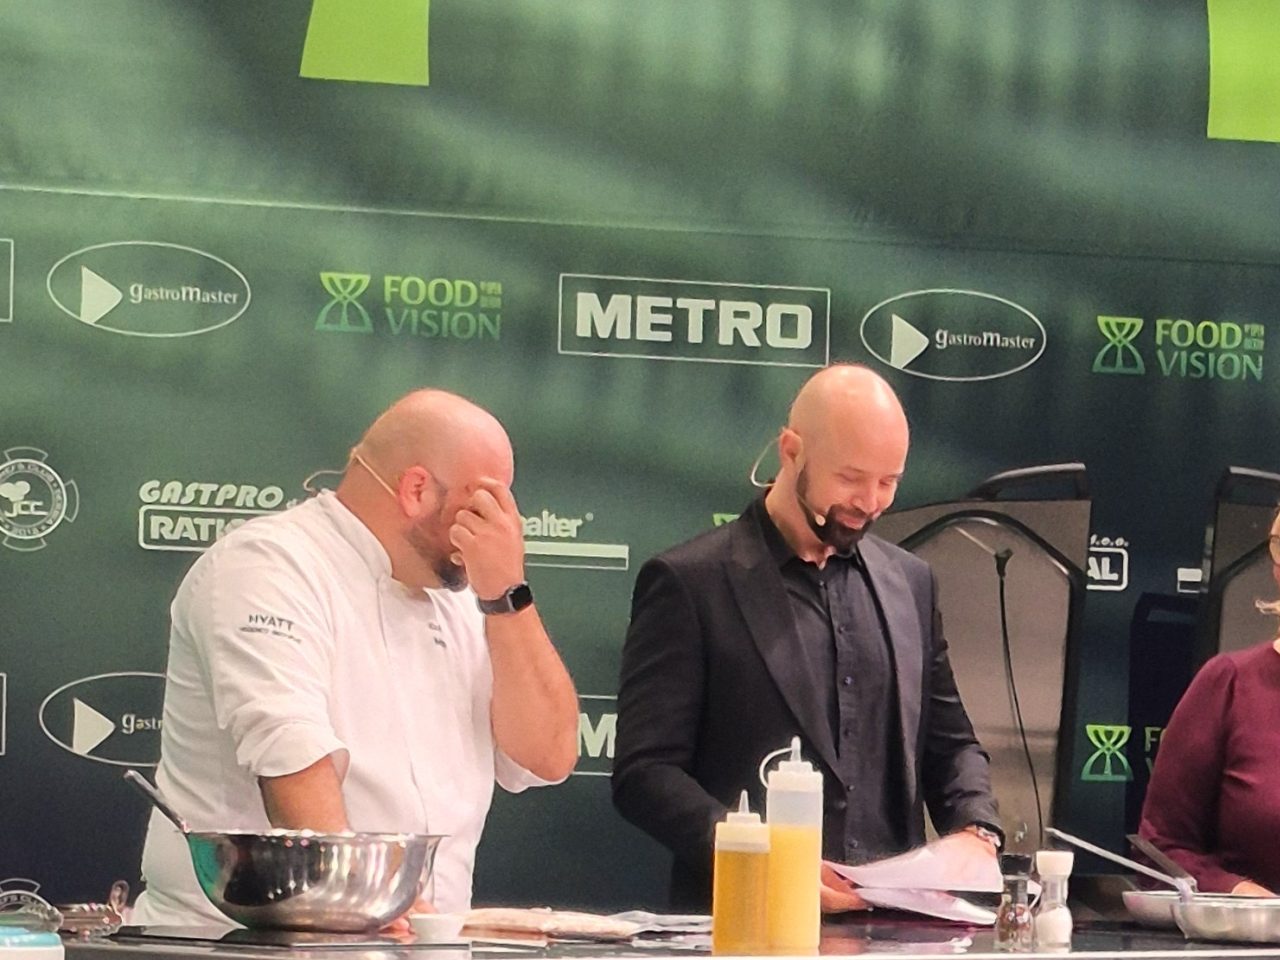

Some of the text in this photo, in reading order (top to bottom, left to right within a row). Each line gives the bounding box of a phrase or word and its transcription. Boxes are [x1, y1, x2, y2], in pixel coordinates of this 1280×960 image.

[130, 283, 239, 305] gastroMaster
[384, 275, 478, 307] FOOD
[385, 307, 501, 340] VISION
[576, 292, 813, 349] METRO
[1155, 319, 1242, 349] FOOD
[935, 328, 1035, 349] gastroMaster
[1156, 350, 1263, 381] VISION
[139, 480, 284, 508] GASTPRO
